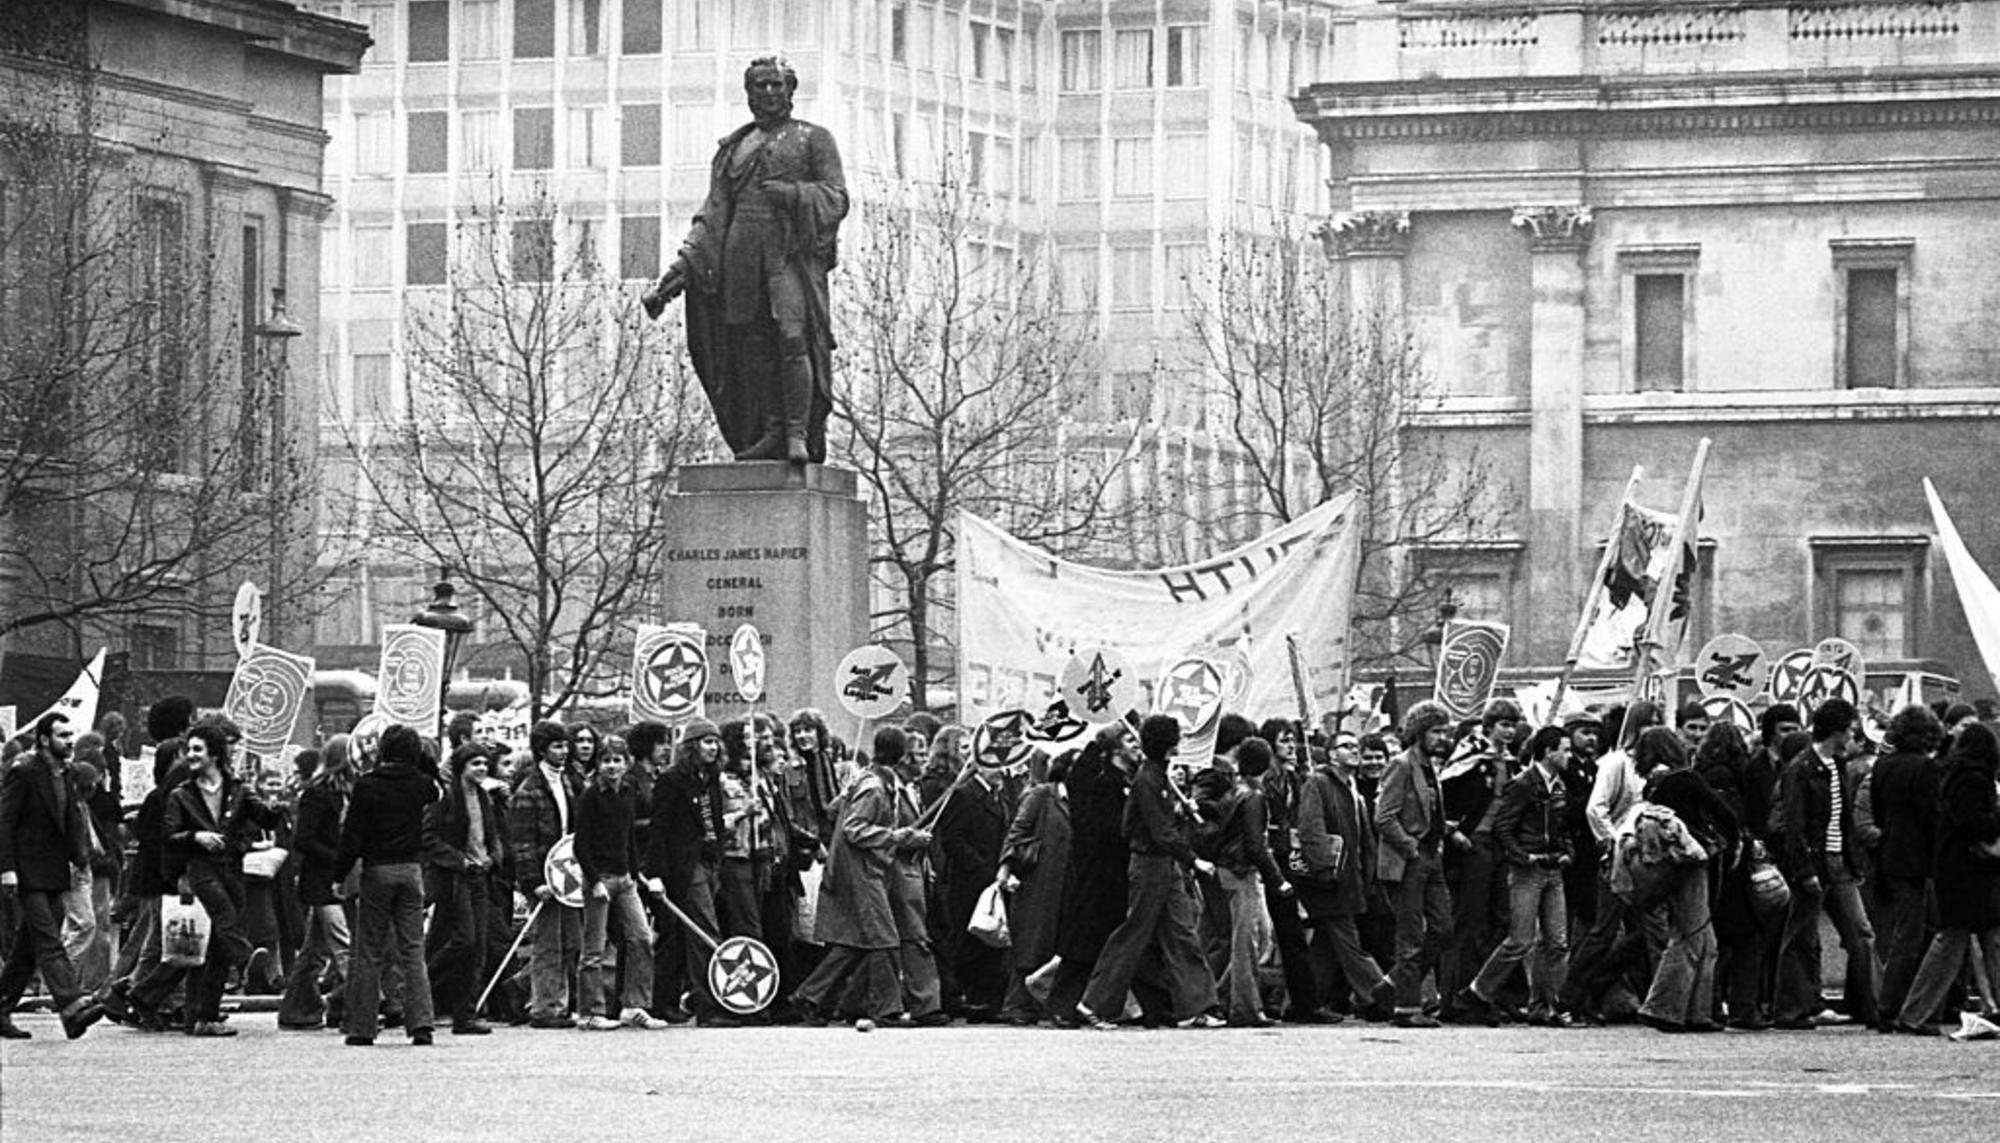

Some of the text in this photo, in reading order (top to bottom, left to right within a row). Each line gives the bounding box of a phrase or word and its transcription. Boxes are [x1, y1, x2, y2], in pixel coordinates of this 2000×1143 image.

[668, 547, 809, 562] CHARLES JAMES NAPIER
[706, 577, 763, 590] GENERAL
[718, 606, 754, 618] BORN
